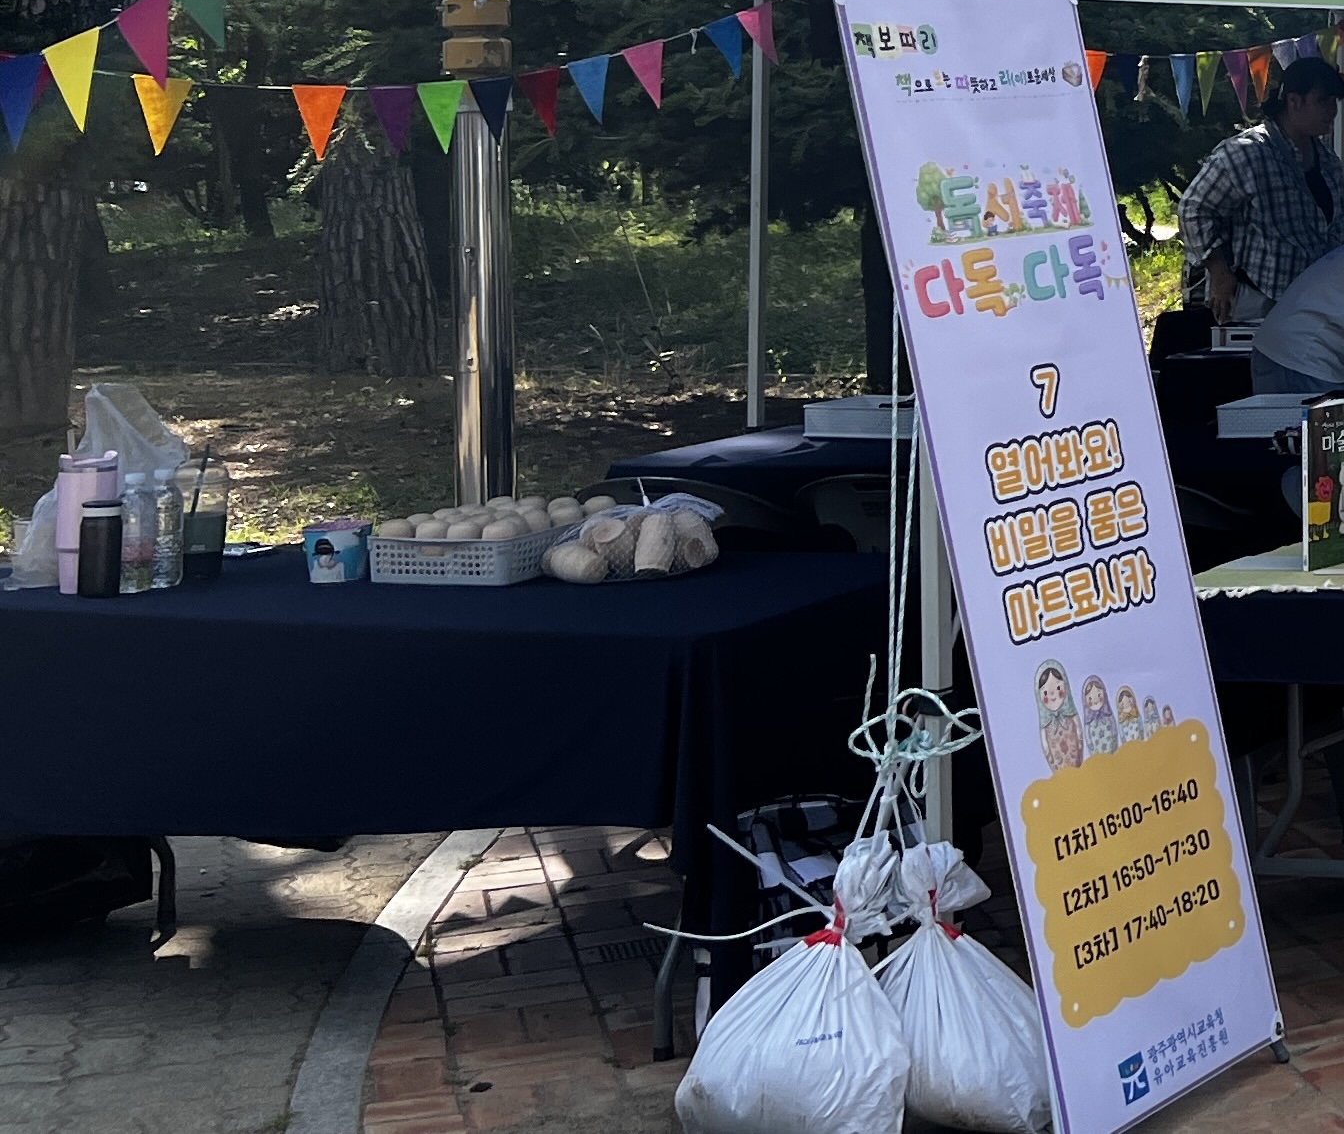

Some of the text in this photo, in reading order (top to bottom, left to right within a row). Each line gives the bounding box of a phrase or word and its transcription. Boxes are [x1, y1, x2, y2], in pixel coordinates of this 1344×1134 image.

[940, 176, 1082, 239] 독서축제
[1031, 363, 1060, 417] 7
[987, 420, 1123, 502] 열어봐요!
[986, 482, 1146, 574] 비밀을 품은
[1004, 548, 1155, 644] 마트료시카
[1054, 778, 1199, 862] [1차] 16:00~16:40
[1062, 828, 1211, 917] [2차] 16:50~17:30
[1073, 878, 1221, 970] [3차] 17:40~18:20
[1147, 1006, 1225, 1064] 광주광역시교육청
[1153, 1026, 1230, 1086] 유아교육진흥원
